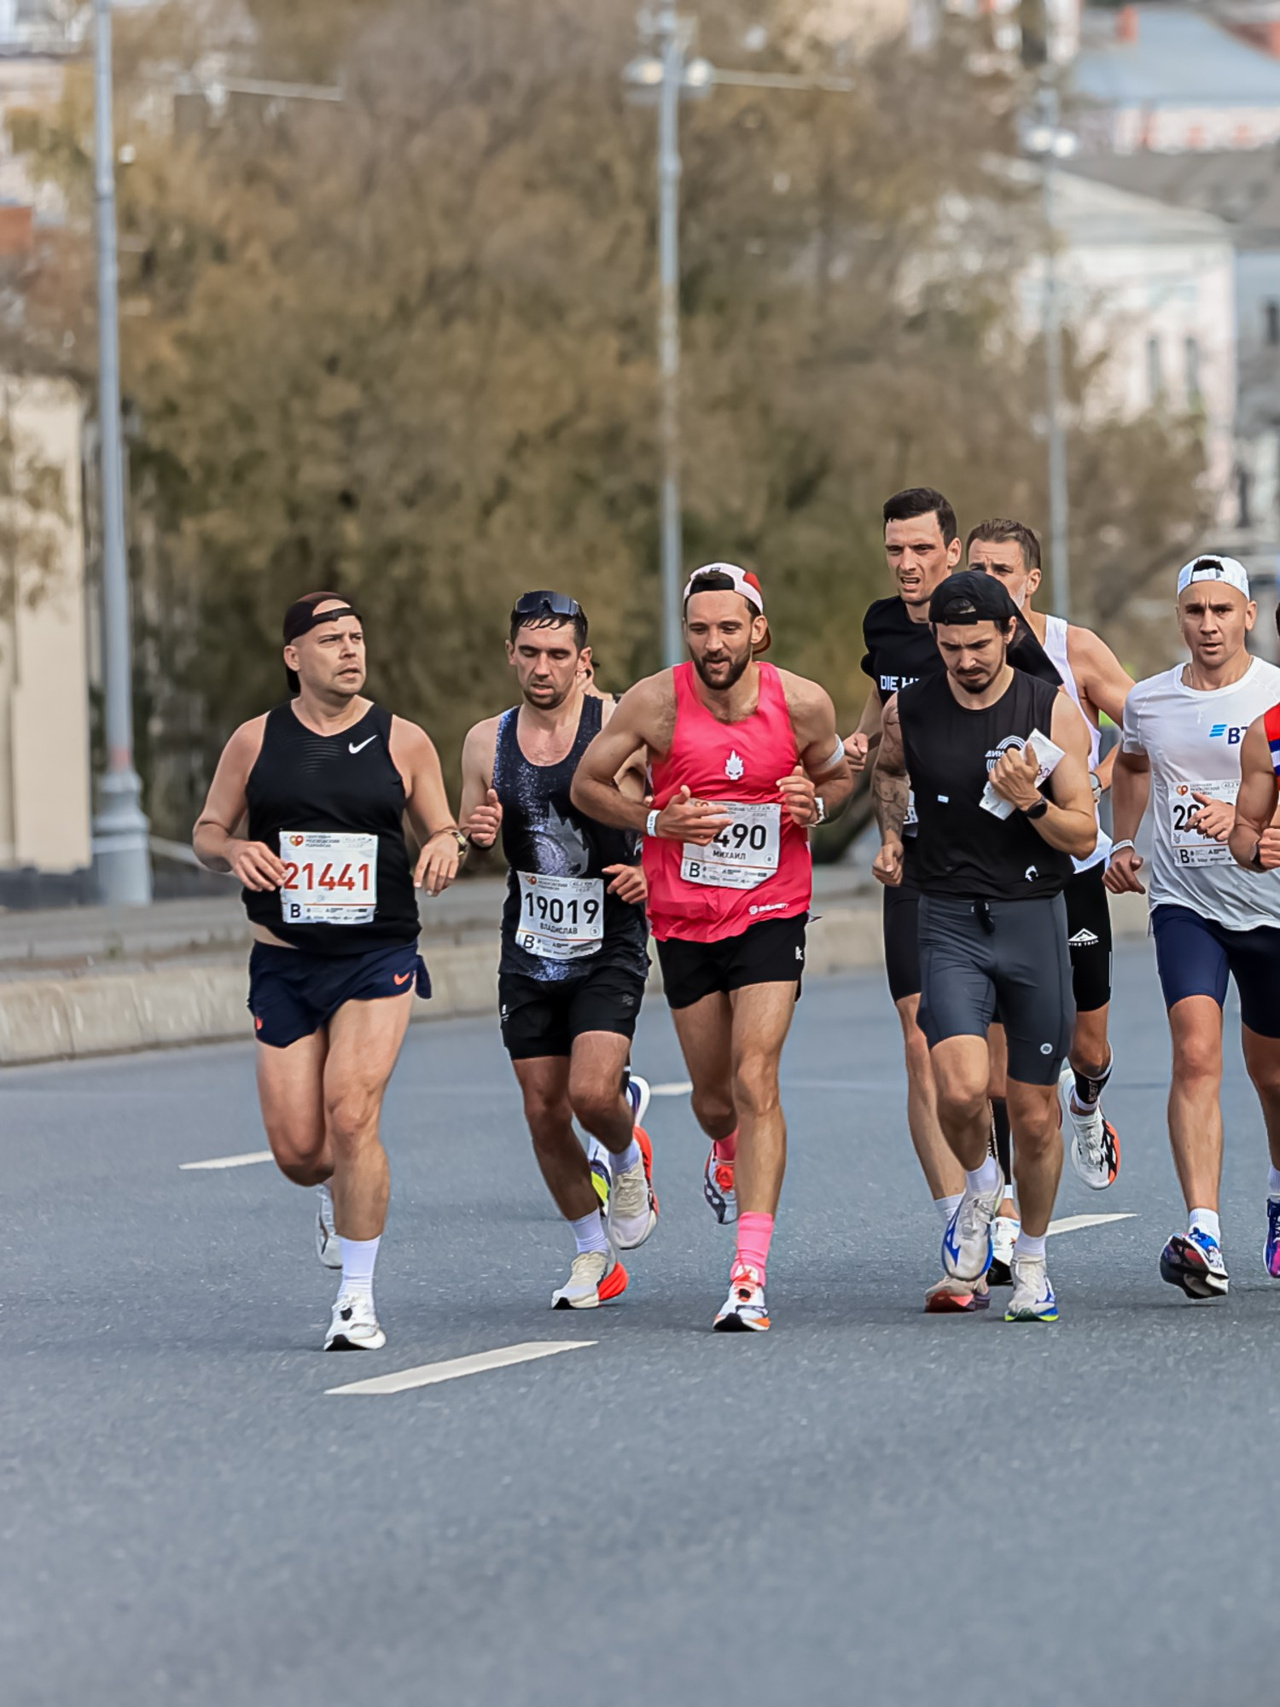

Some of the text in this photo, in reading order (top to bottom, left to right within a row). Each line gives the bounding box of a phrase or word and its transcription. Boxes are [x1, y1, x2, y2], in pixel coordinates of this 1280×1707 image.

[880, 675, 899, 691] DIE
[713, 823, 767, 851] 490
[712, 850, 747, 860] МИХАИЛ
[283, 862, 369, 891] 21441
[525, 891, 600, 924] 19019
[540, 922, 578, 935] ВЛАДИСЛАВ
